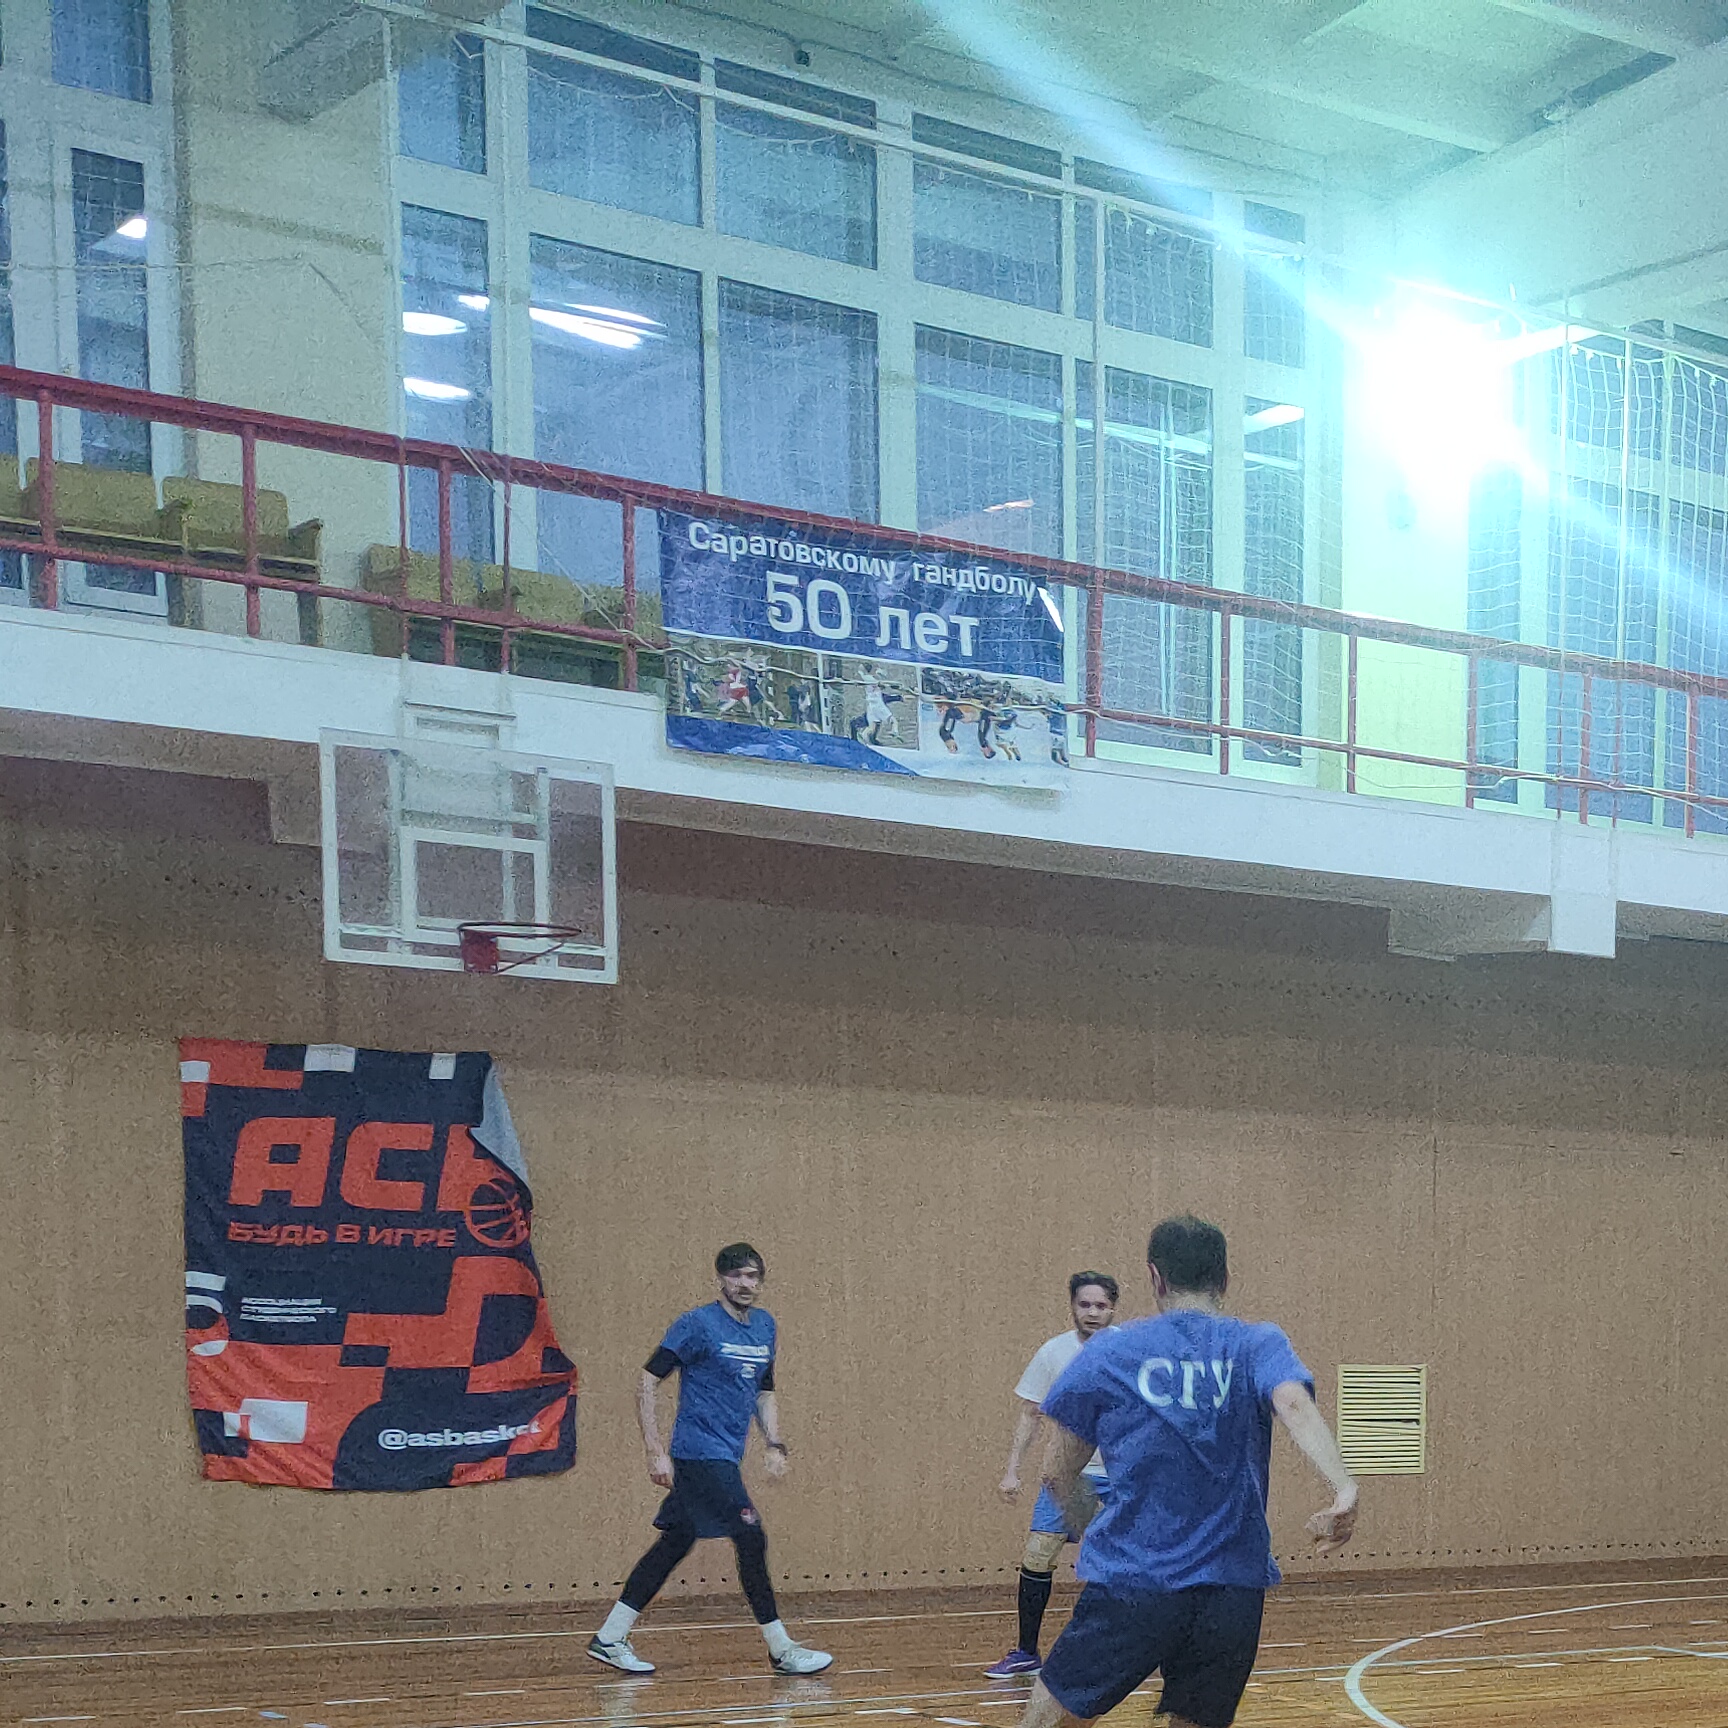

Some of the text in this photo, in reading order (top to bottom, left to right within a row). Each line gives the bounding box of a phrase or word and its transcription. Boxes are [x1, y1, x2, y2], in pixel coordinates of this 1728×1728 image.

[688, 521, 1037, 605] Саратовскому гандболу
[765, 570, 981, 657] 50 лет
[227, 1220, 457, 1248] БУДЬ В ИГРЕ
